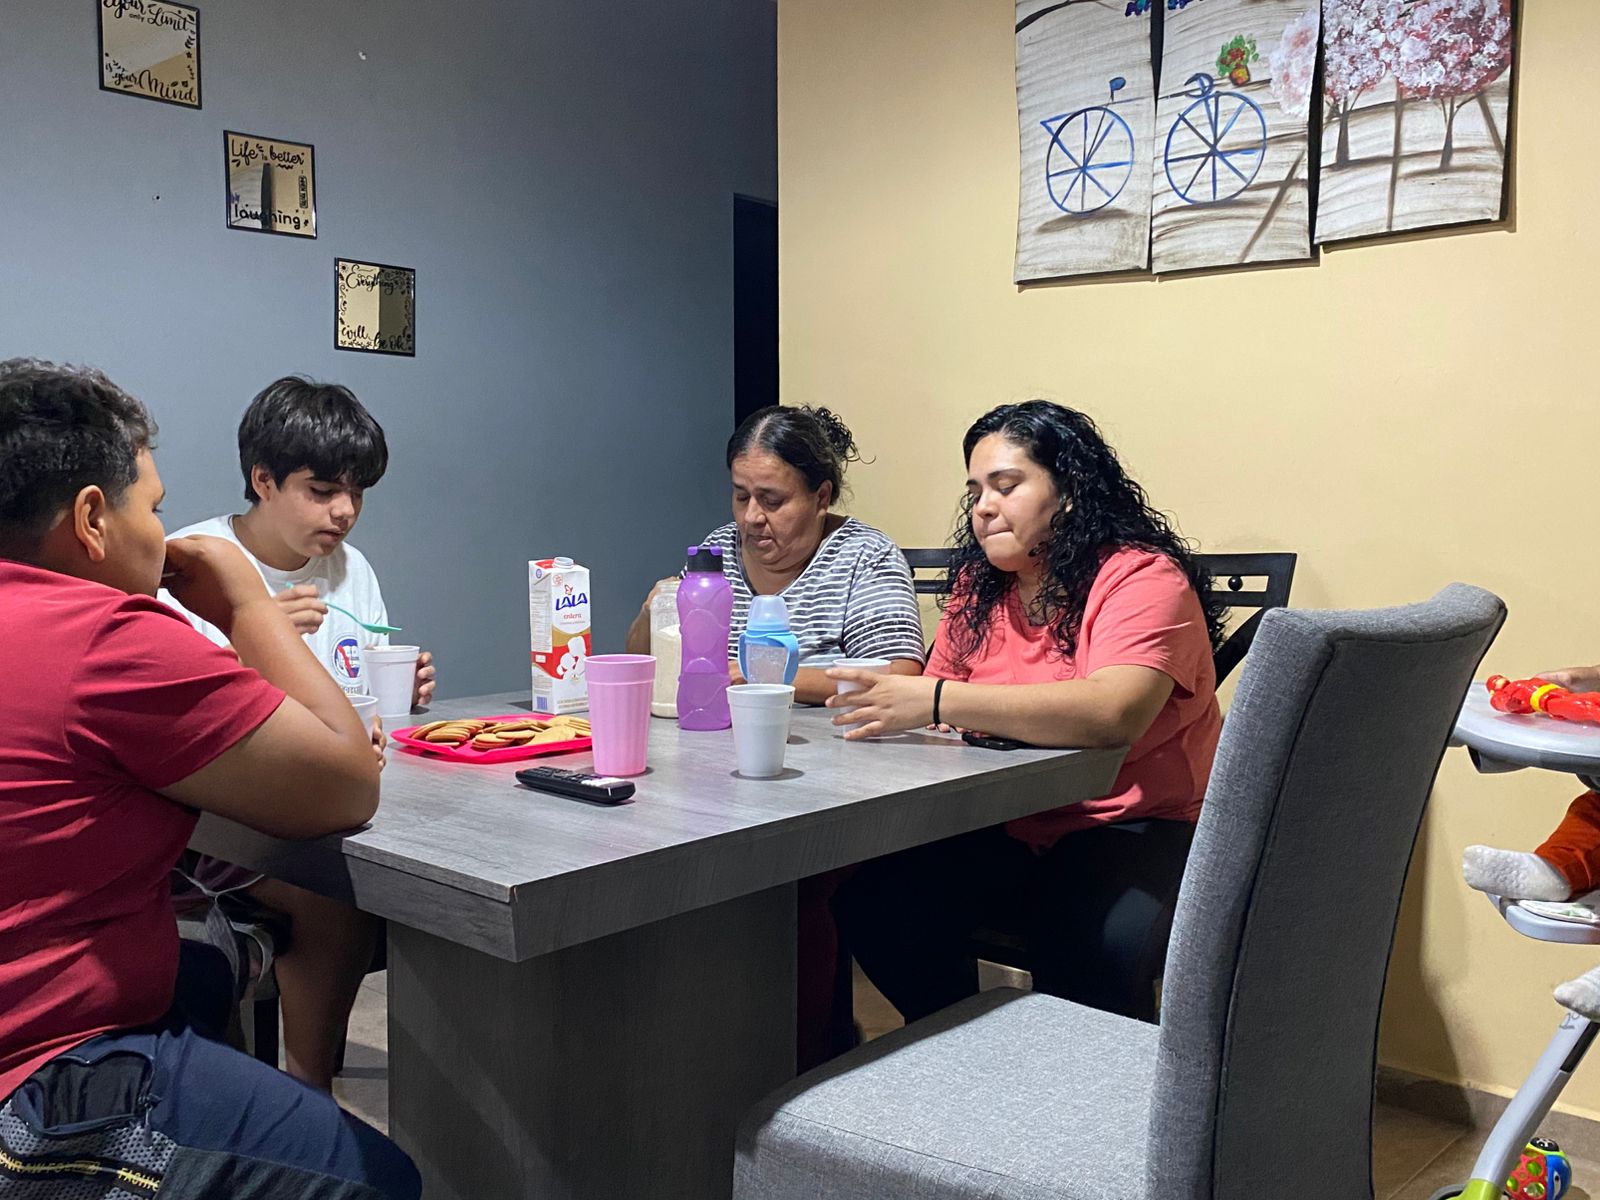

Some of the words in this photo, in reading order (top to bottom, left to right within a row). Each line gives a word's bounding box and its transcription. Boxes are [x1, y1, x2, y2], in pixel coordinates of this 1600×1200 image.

[147, 7, 196, 31] Limit
[112, 72, 138, 86] your
[138, 69, 197, 103] Mind
[231, 139, 258, 166] Life
[269, 145, 304, 165] better
[555, 592, 588, 611] LALA
